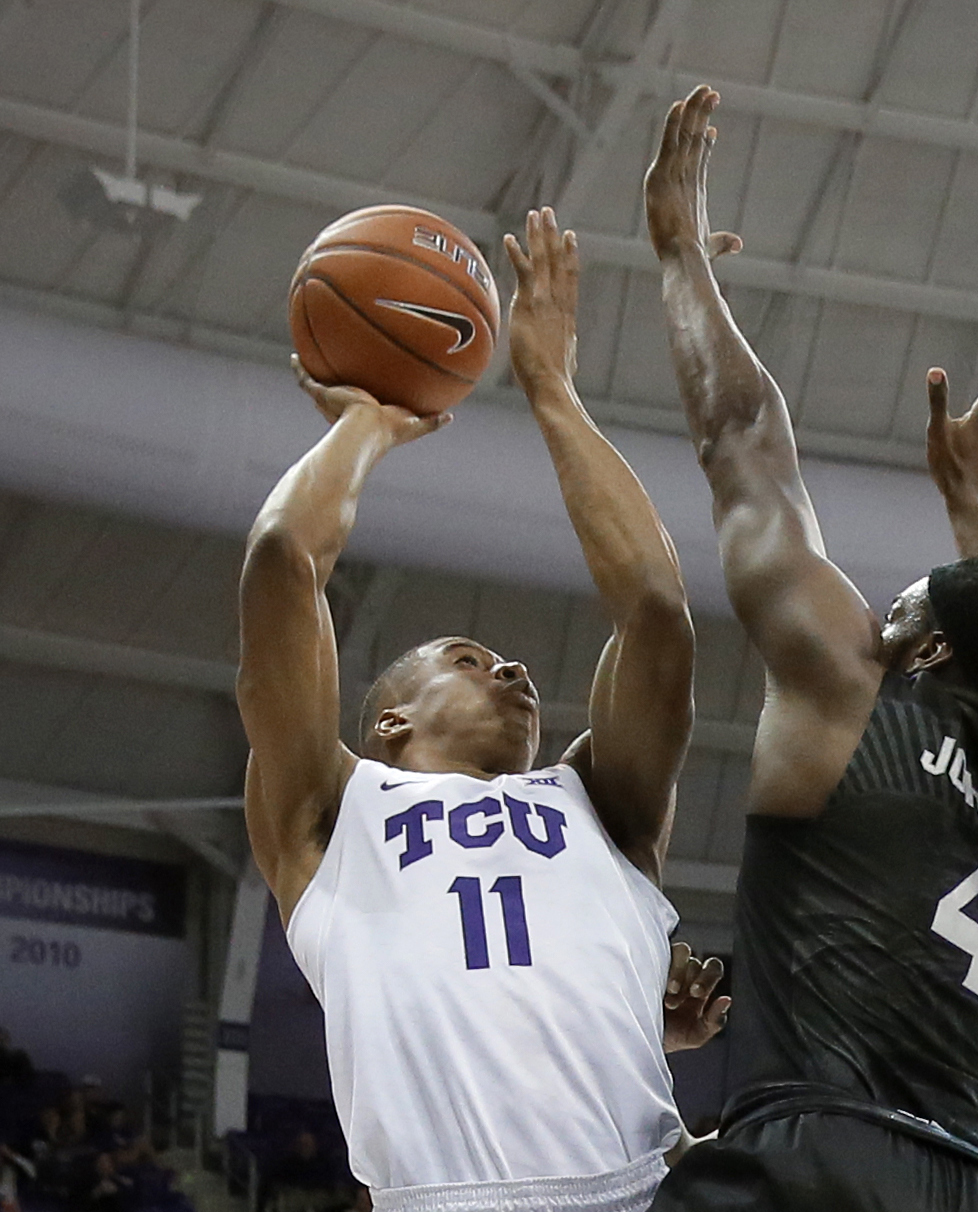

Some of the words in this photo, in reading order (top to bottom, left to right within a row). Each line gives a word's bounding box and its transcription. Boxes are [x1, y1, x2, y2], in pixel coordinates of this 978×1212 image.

[384, 791, 567, 871] TCU
[0, 874, 156, 922] PIONSHIPS
[447, 875, 532, 970] 11
[10, 935, 82, 968] 2010
